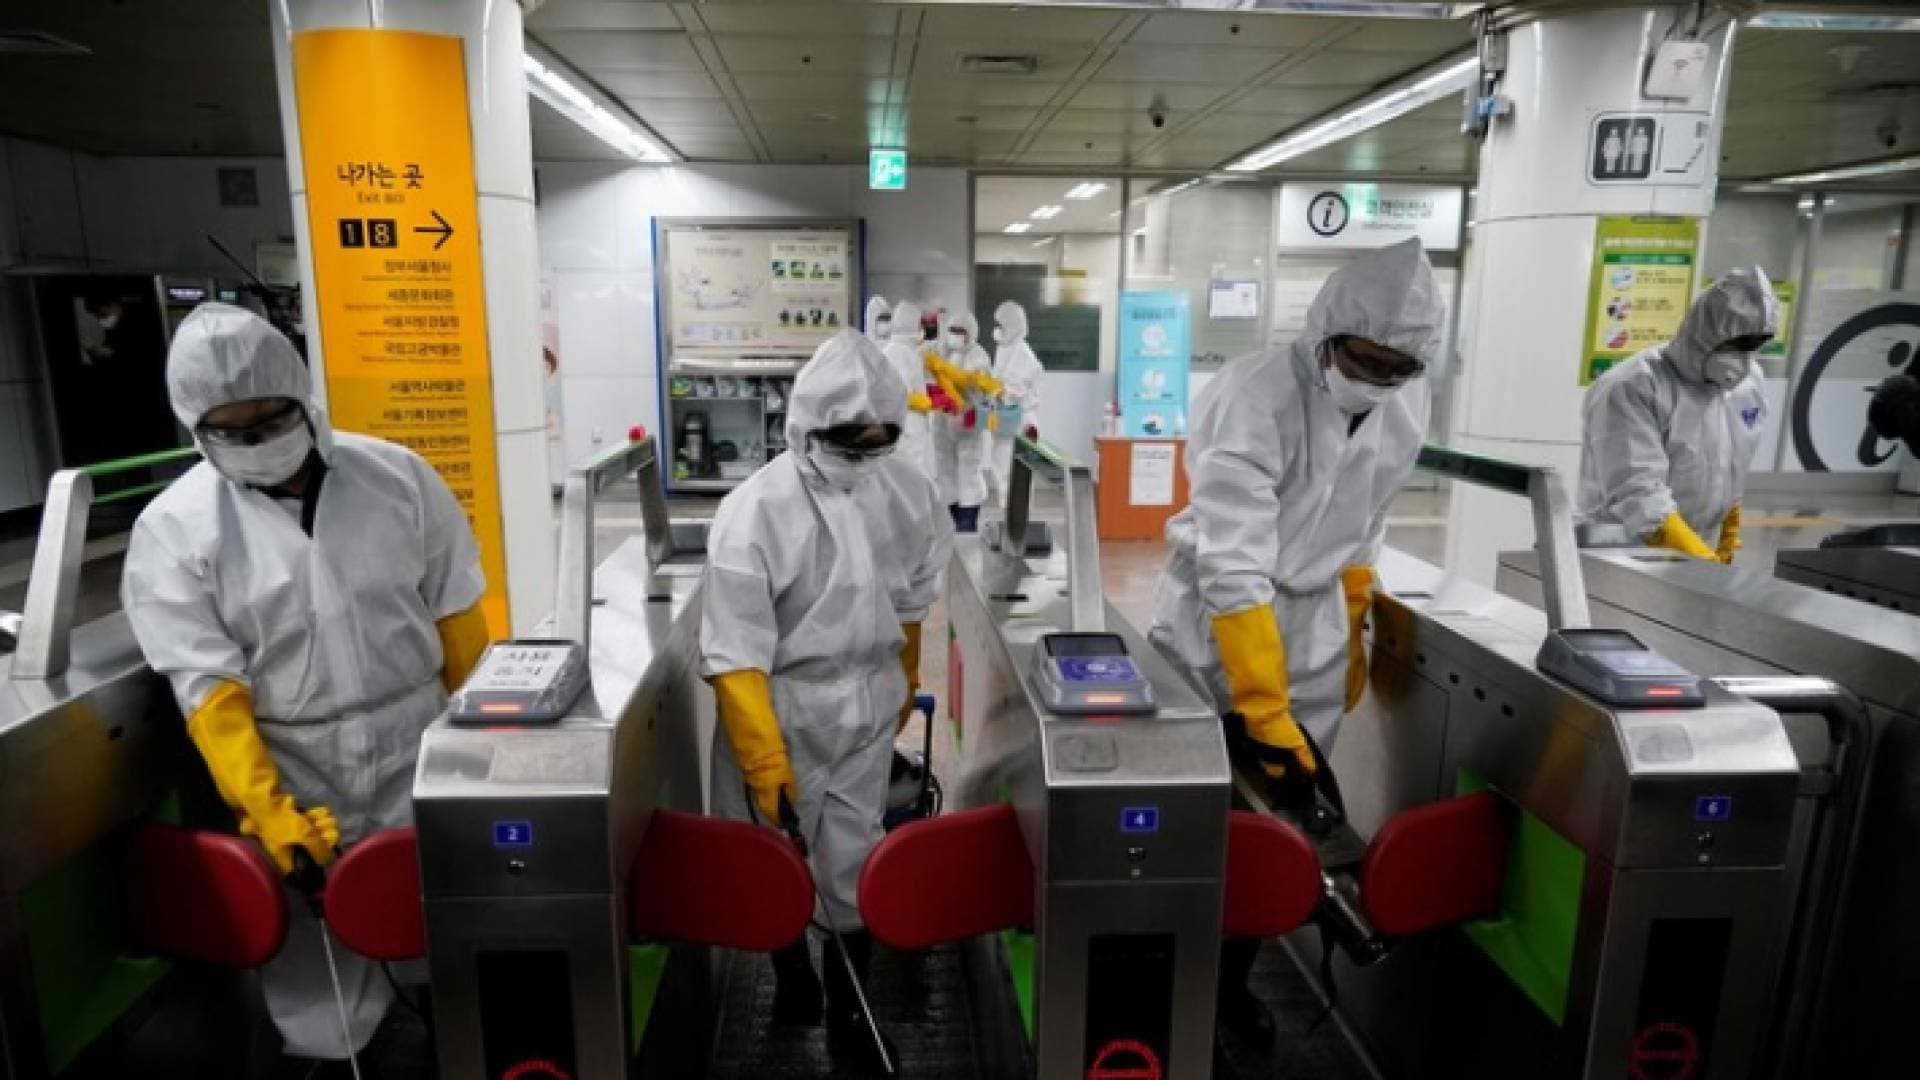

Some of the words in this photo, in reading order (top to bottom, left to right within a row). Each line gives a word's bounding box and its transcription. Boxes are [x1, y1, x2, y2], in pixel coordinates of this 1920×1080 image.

[337, 161, 396, 189] 나가는
[402, 163, 425, 189] 곳
[357, 191, 380, 204] Exit
